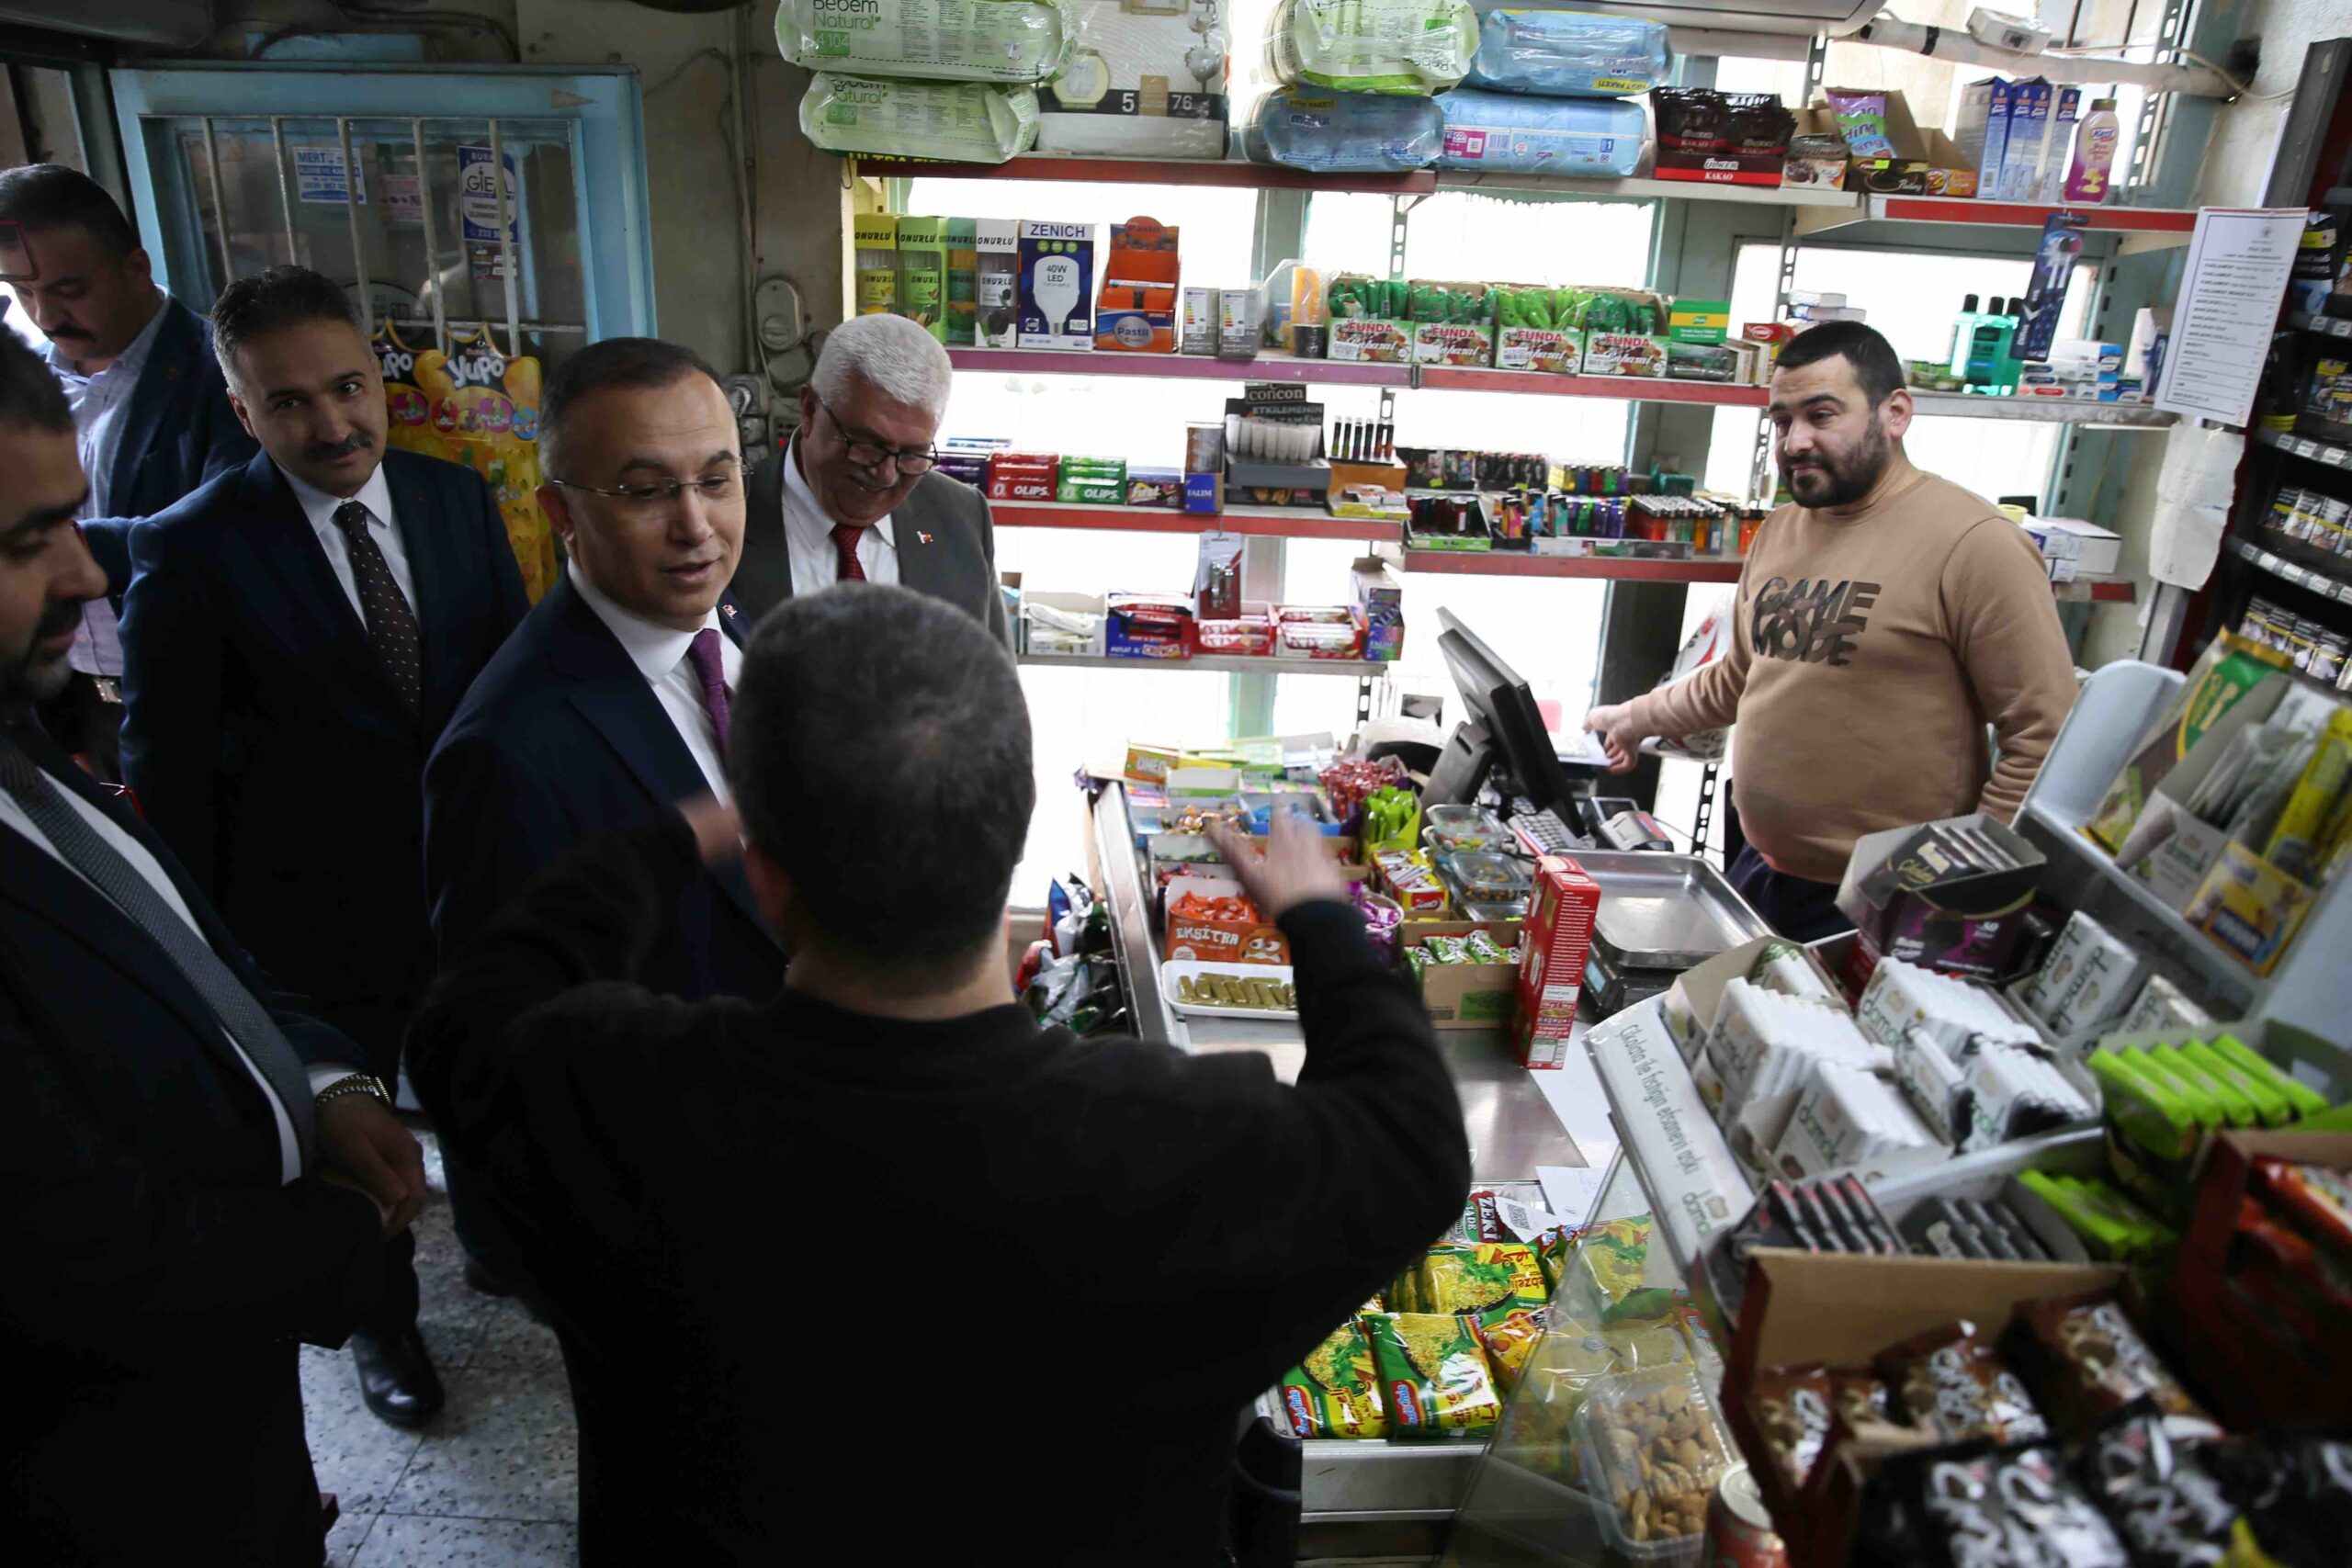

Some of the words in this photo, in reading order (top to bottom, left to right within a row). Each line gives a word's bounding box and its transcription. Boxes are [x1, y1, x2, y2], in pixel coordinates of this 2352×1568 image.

[813, 13, 875, 30] Natural
[835, 91, 877, 105] atural
[1121, 93, 1135, 112] 5
[1171, 95, 1193, 110] 76
[298, 152, 325, 163] MERT
[1703, 171, 1734, 182] KAKAO
[1030, 224, 1085, 239] ZENICH
[899, 232, 937, 244] ONURLU
[977, 235, 1015, 246] ONURLU
[1046, 265, 1068, 275] 40W
[1046, 274, 1064, 283] LED
[1116, 326, 1150, 338] Pastil
[1348, 321, 1393, 333] FUNDA
[1431, 327, 1476, 338] FUNDA
[1517, 330, 1564, 343] FUNDA
[1604, 335, 1651, 347] FUNDA
[1755, 576, 1882, 634] GAME
[1751, 606, 1865, 667] MODE
[1175, 924, 1239, 945] EKSİTRA
[1619, 1023, 1646, 1064] Çikolata
[1636, 1057, 1657, 1077] ile
[1656, 1108, 1689, 1152] efsanevi
[1682, 1189, 1713, 1236] dama
